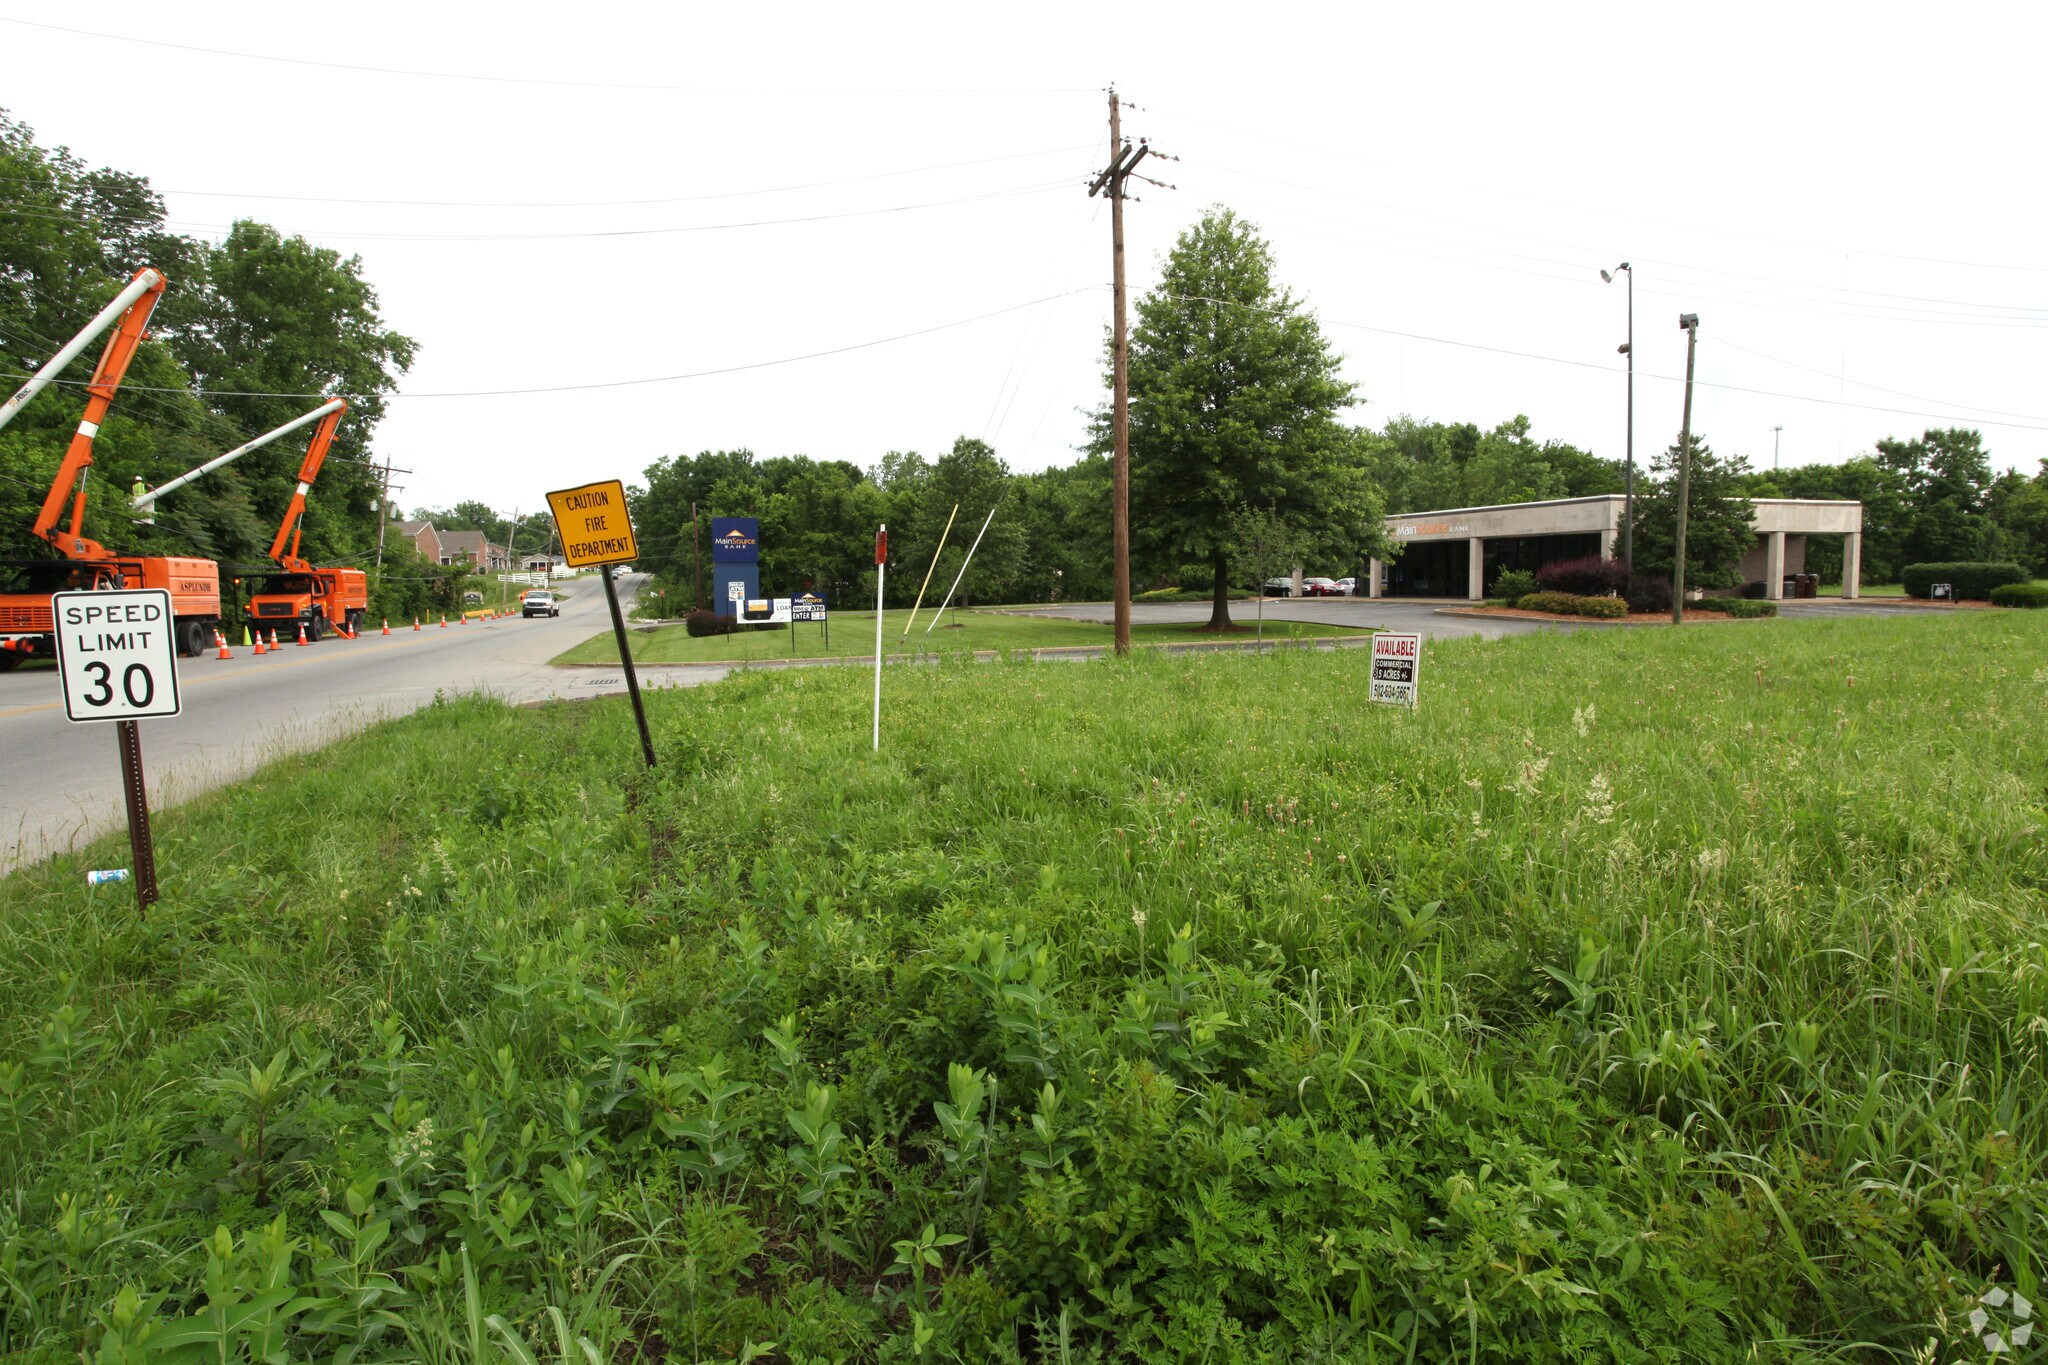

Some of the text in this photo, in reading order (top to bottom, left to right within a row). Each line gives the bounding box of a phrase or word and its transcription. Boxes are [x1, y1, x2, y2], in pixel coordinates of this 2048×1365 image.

[565, 491, 609, 511] CAUTION
[585, 516, 608, 533] FIRE
[1396, 523, 1469, 536] MainSource BANK
[569, 537, 629, 559] DEPARTMENT
[715, 537, 756, 545] MainSource
[179, 581, 212, 592] ASPLUNDH
[66, 604, 161, 625] SPEED
[78, 632, 152, 652] LIMIT
[1376, 640, 1415, 656] AVAILABLE
[1376, 660, 1412, 669] COMMERCIAL
[1383, 670, 1401, 680] ACRES
[83, 661, 155, 708] 30
